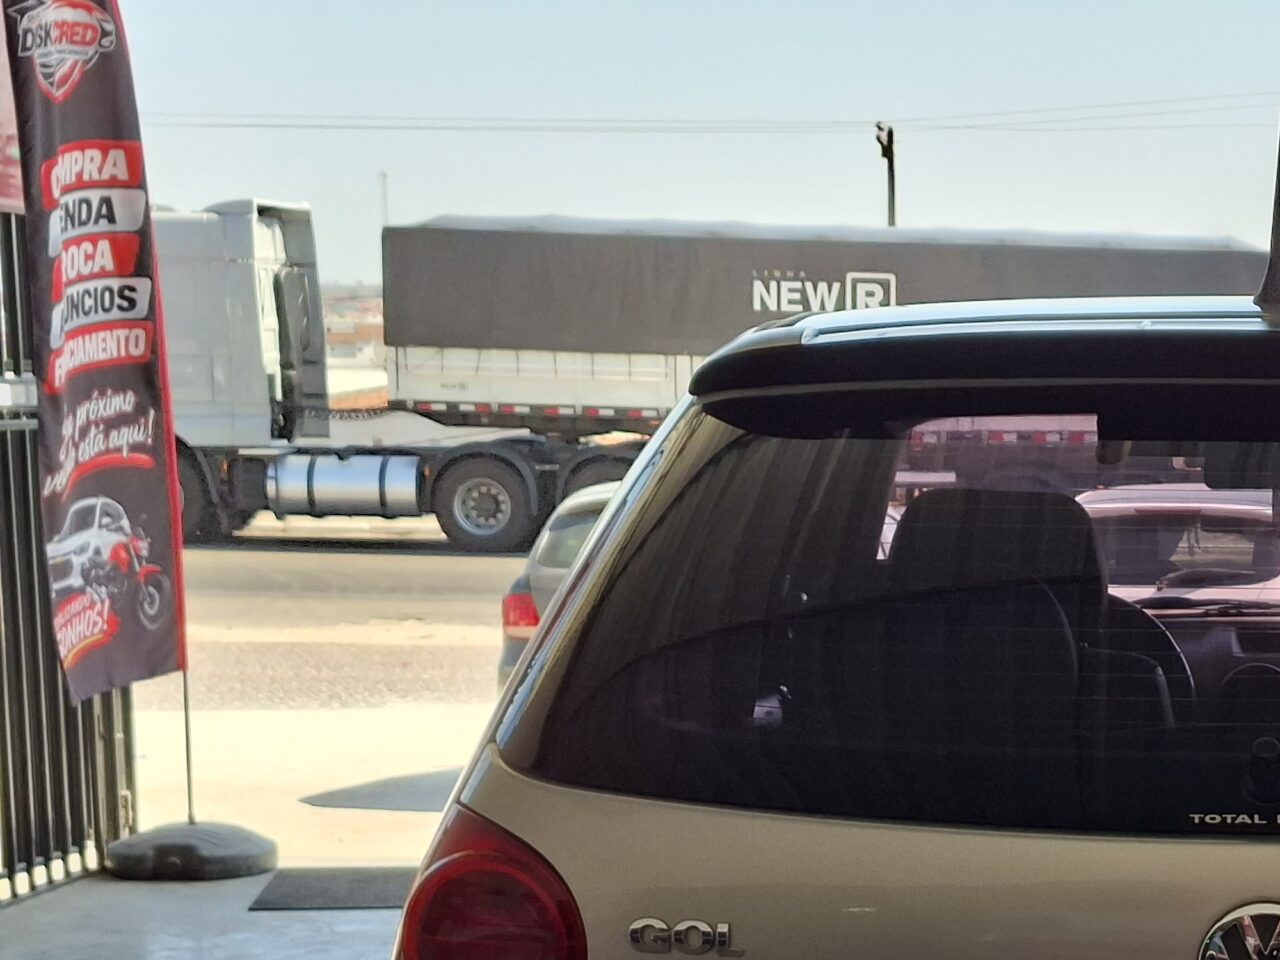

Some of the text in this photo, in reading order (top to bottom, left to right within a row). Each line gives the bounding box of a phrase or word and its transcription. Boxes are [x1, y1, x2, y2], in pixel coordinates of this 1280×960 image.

[753, 280, 842, 312] NEW
[1189, 814, 1268, 824] TOTAL
[628, 917, 746, 958] GOL
